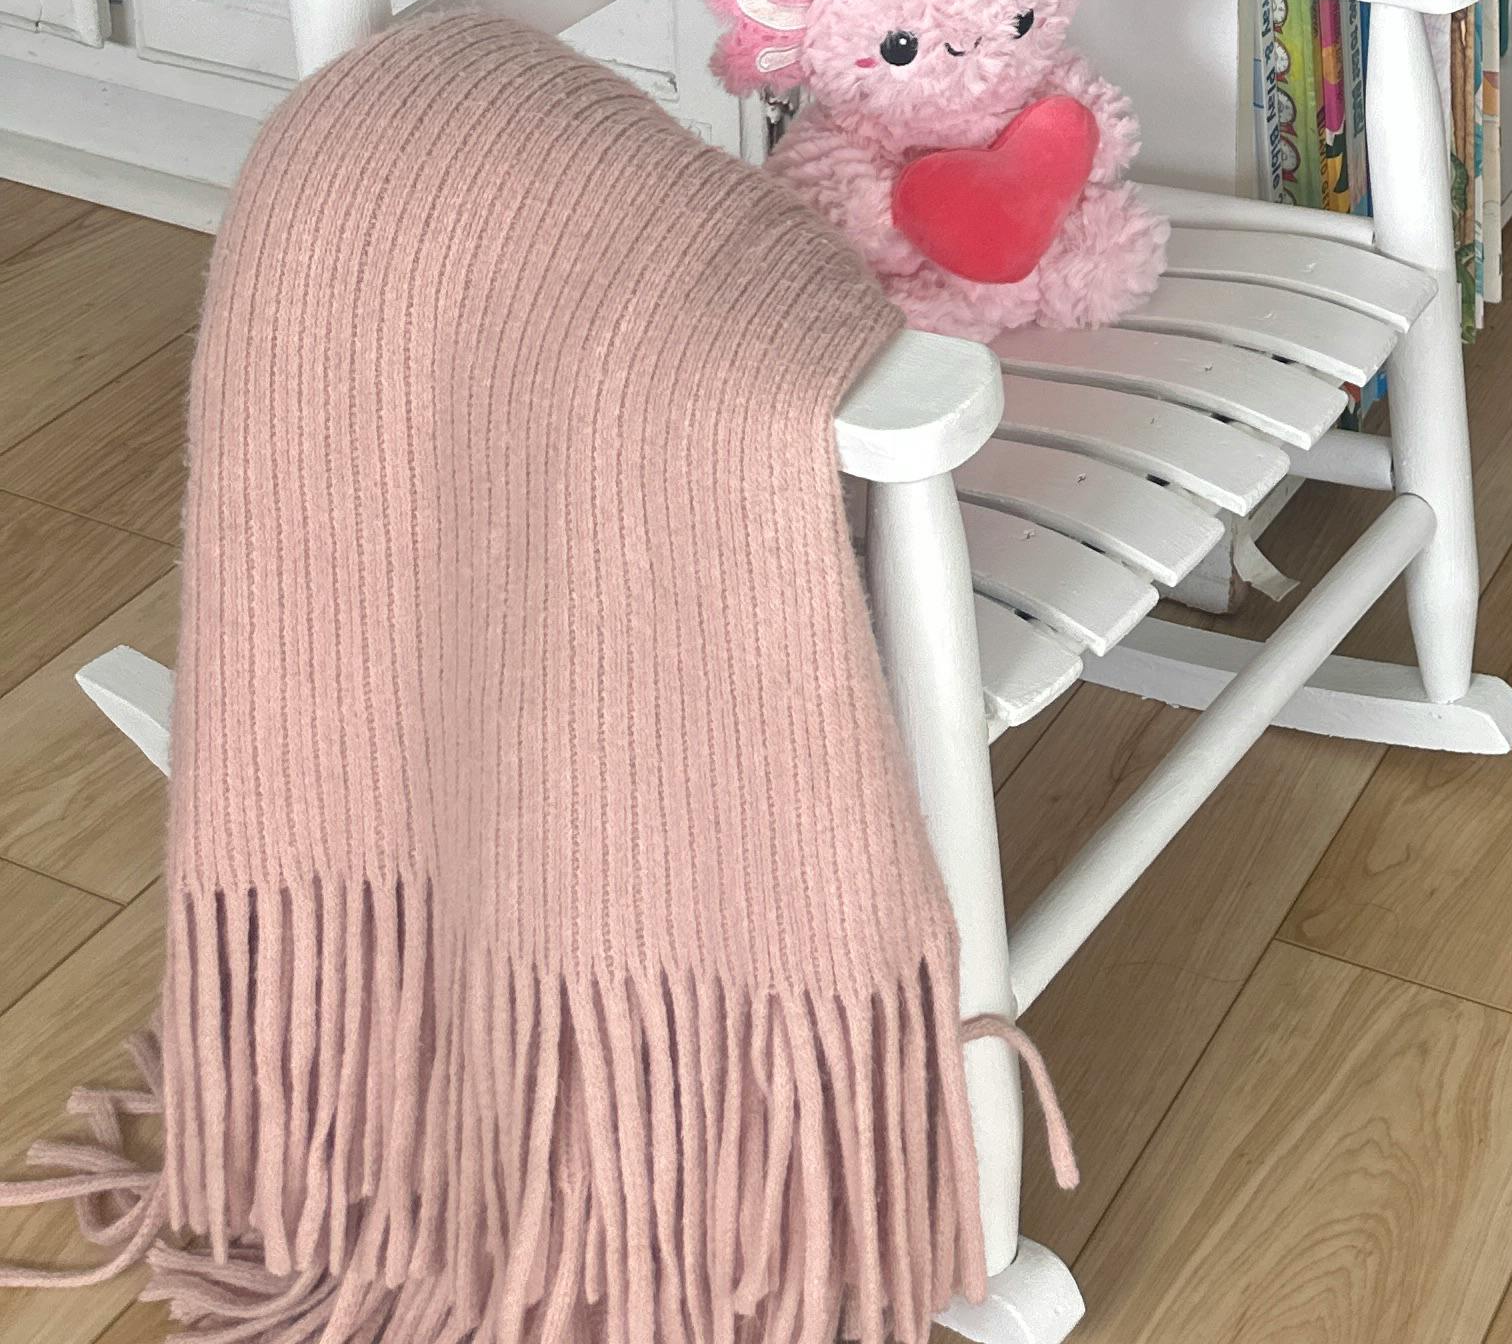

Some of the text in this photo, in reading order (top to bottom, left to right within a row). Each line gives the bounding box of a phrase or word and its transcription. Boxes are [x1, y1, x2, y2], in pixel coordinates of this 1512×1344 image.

[1264, 41, 1274, 61] &
[1266, 69, 1277, 123] Play
[1270, 135, 1283, 190] Bible
